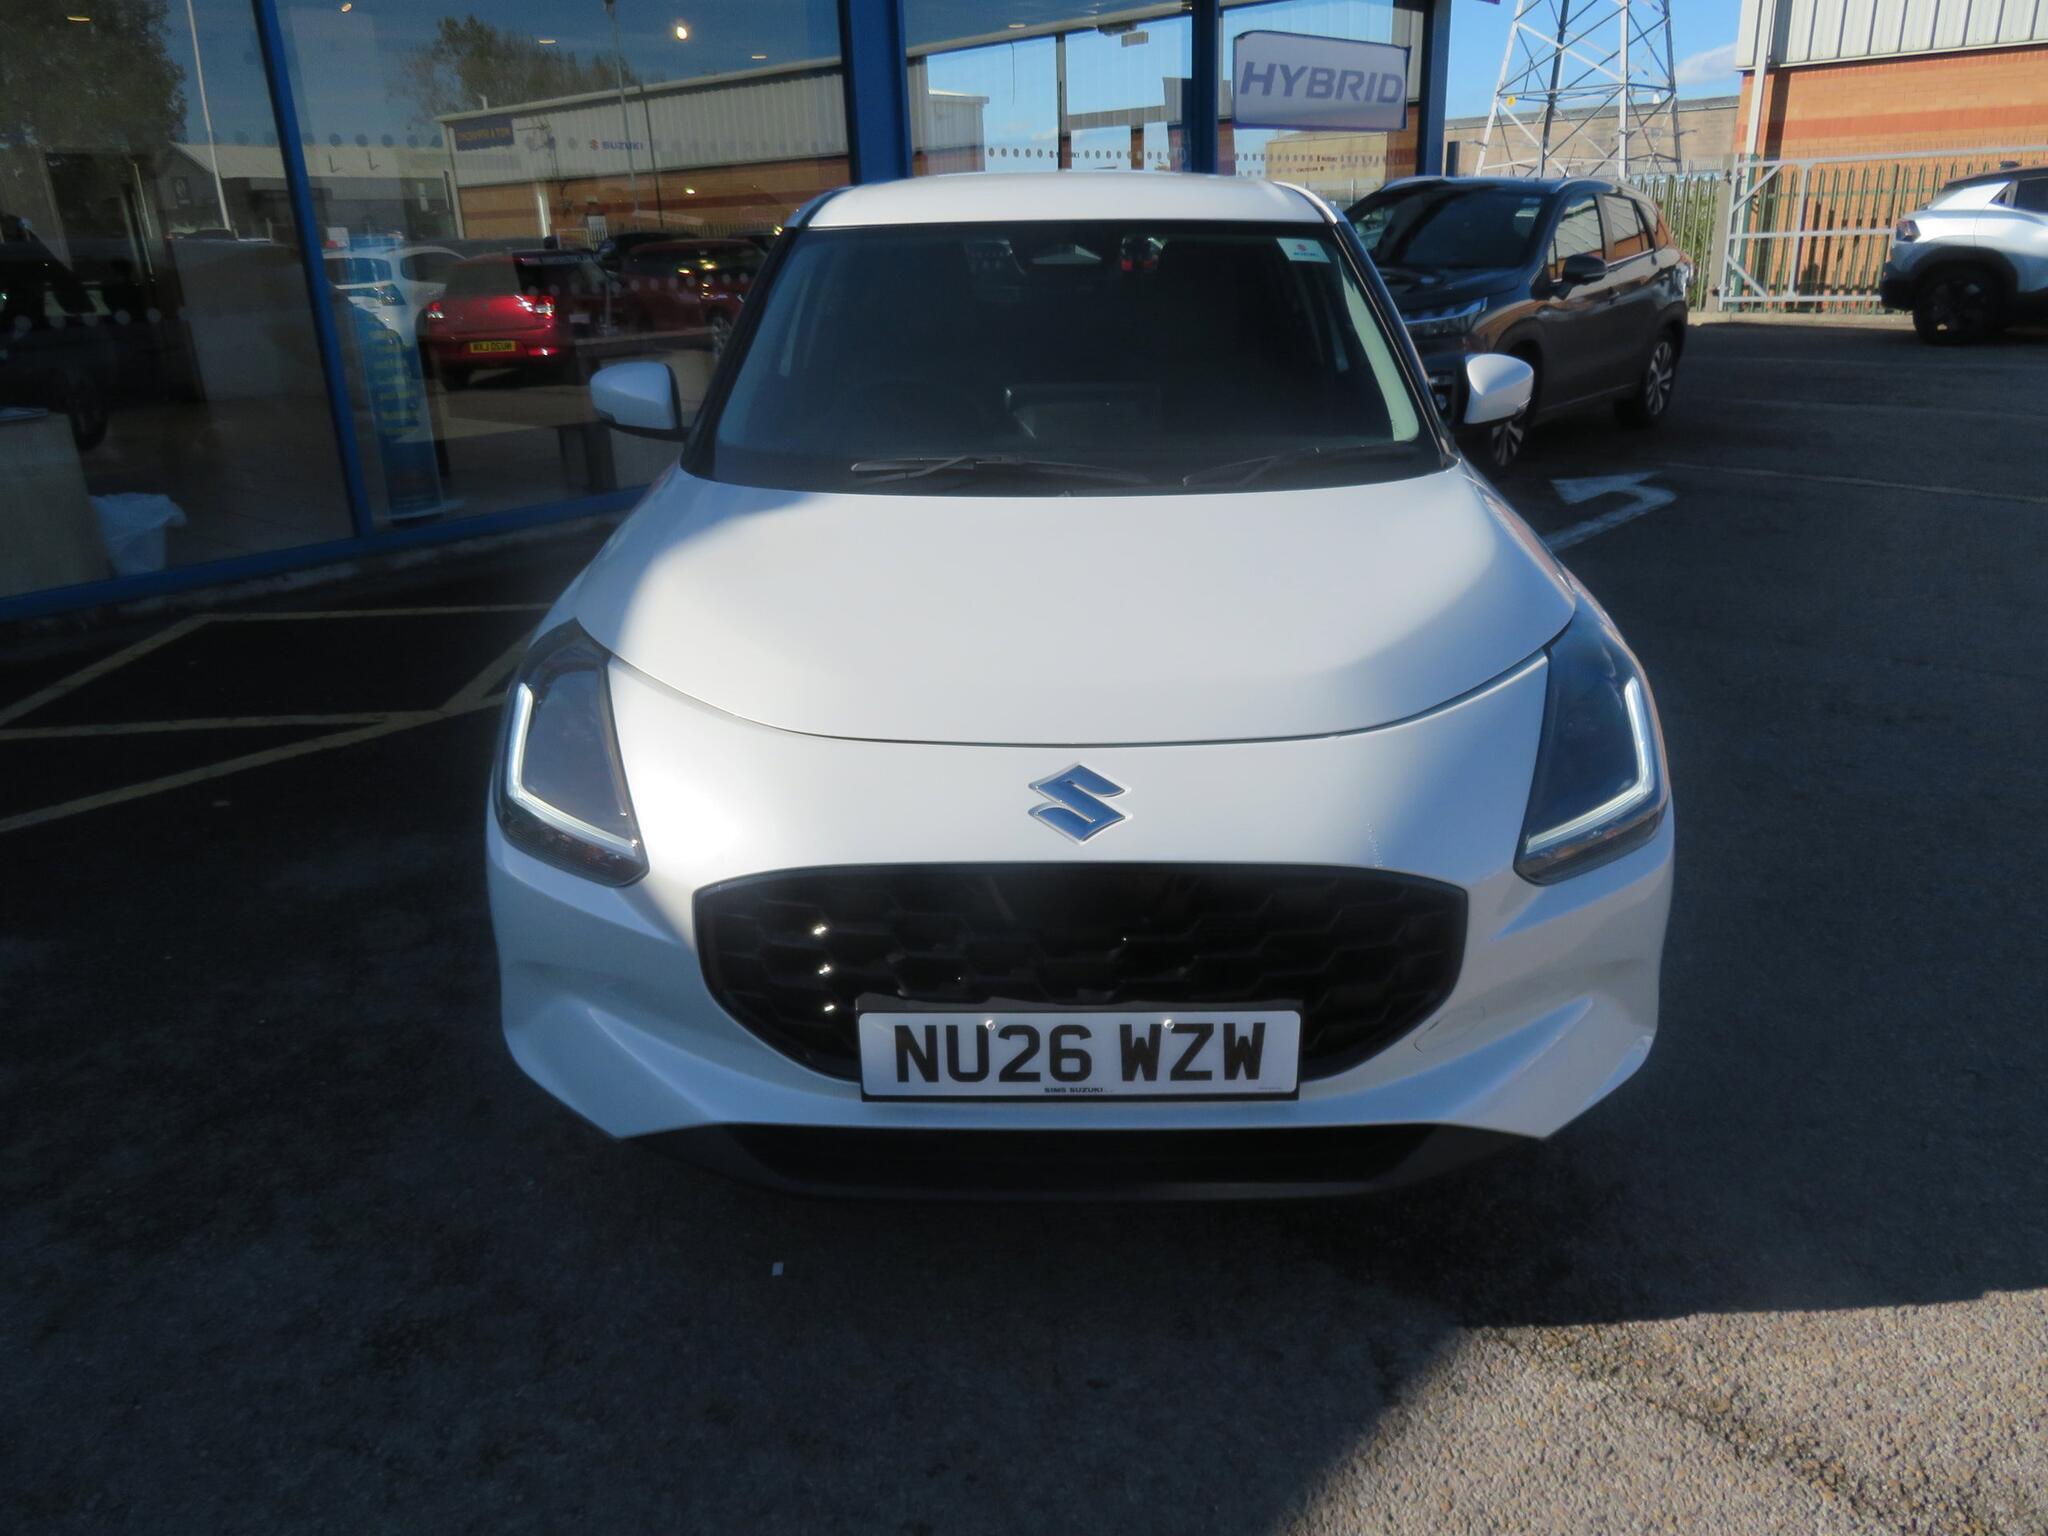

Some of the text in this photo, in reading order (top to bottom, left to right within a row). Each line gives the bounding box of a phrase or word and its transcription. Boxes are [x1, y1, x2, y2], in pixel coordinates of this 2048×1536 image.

[1240, 61, 1403, 103] HYBRID
[894, 1021, 1266, 1083] NU26 WZW
